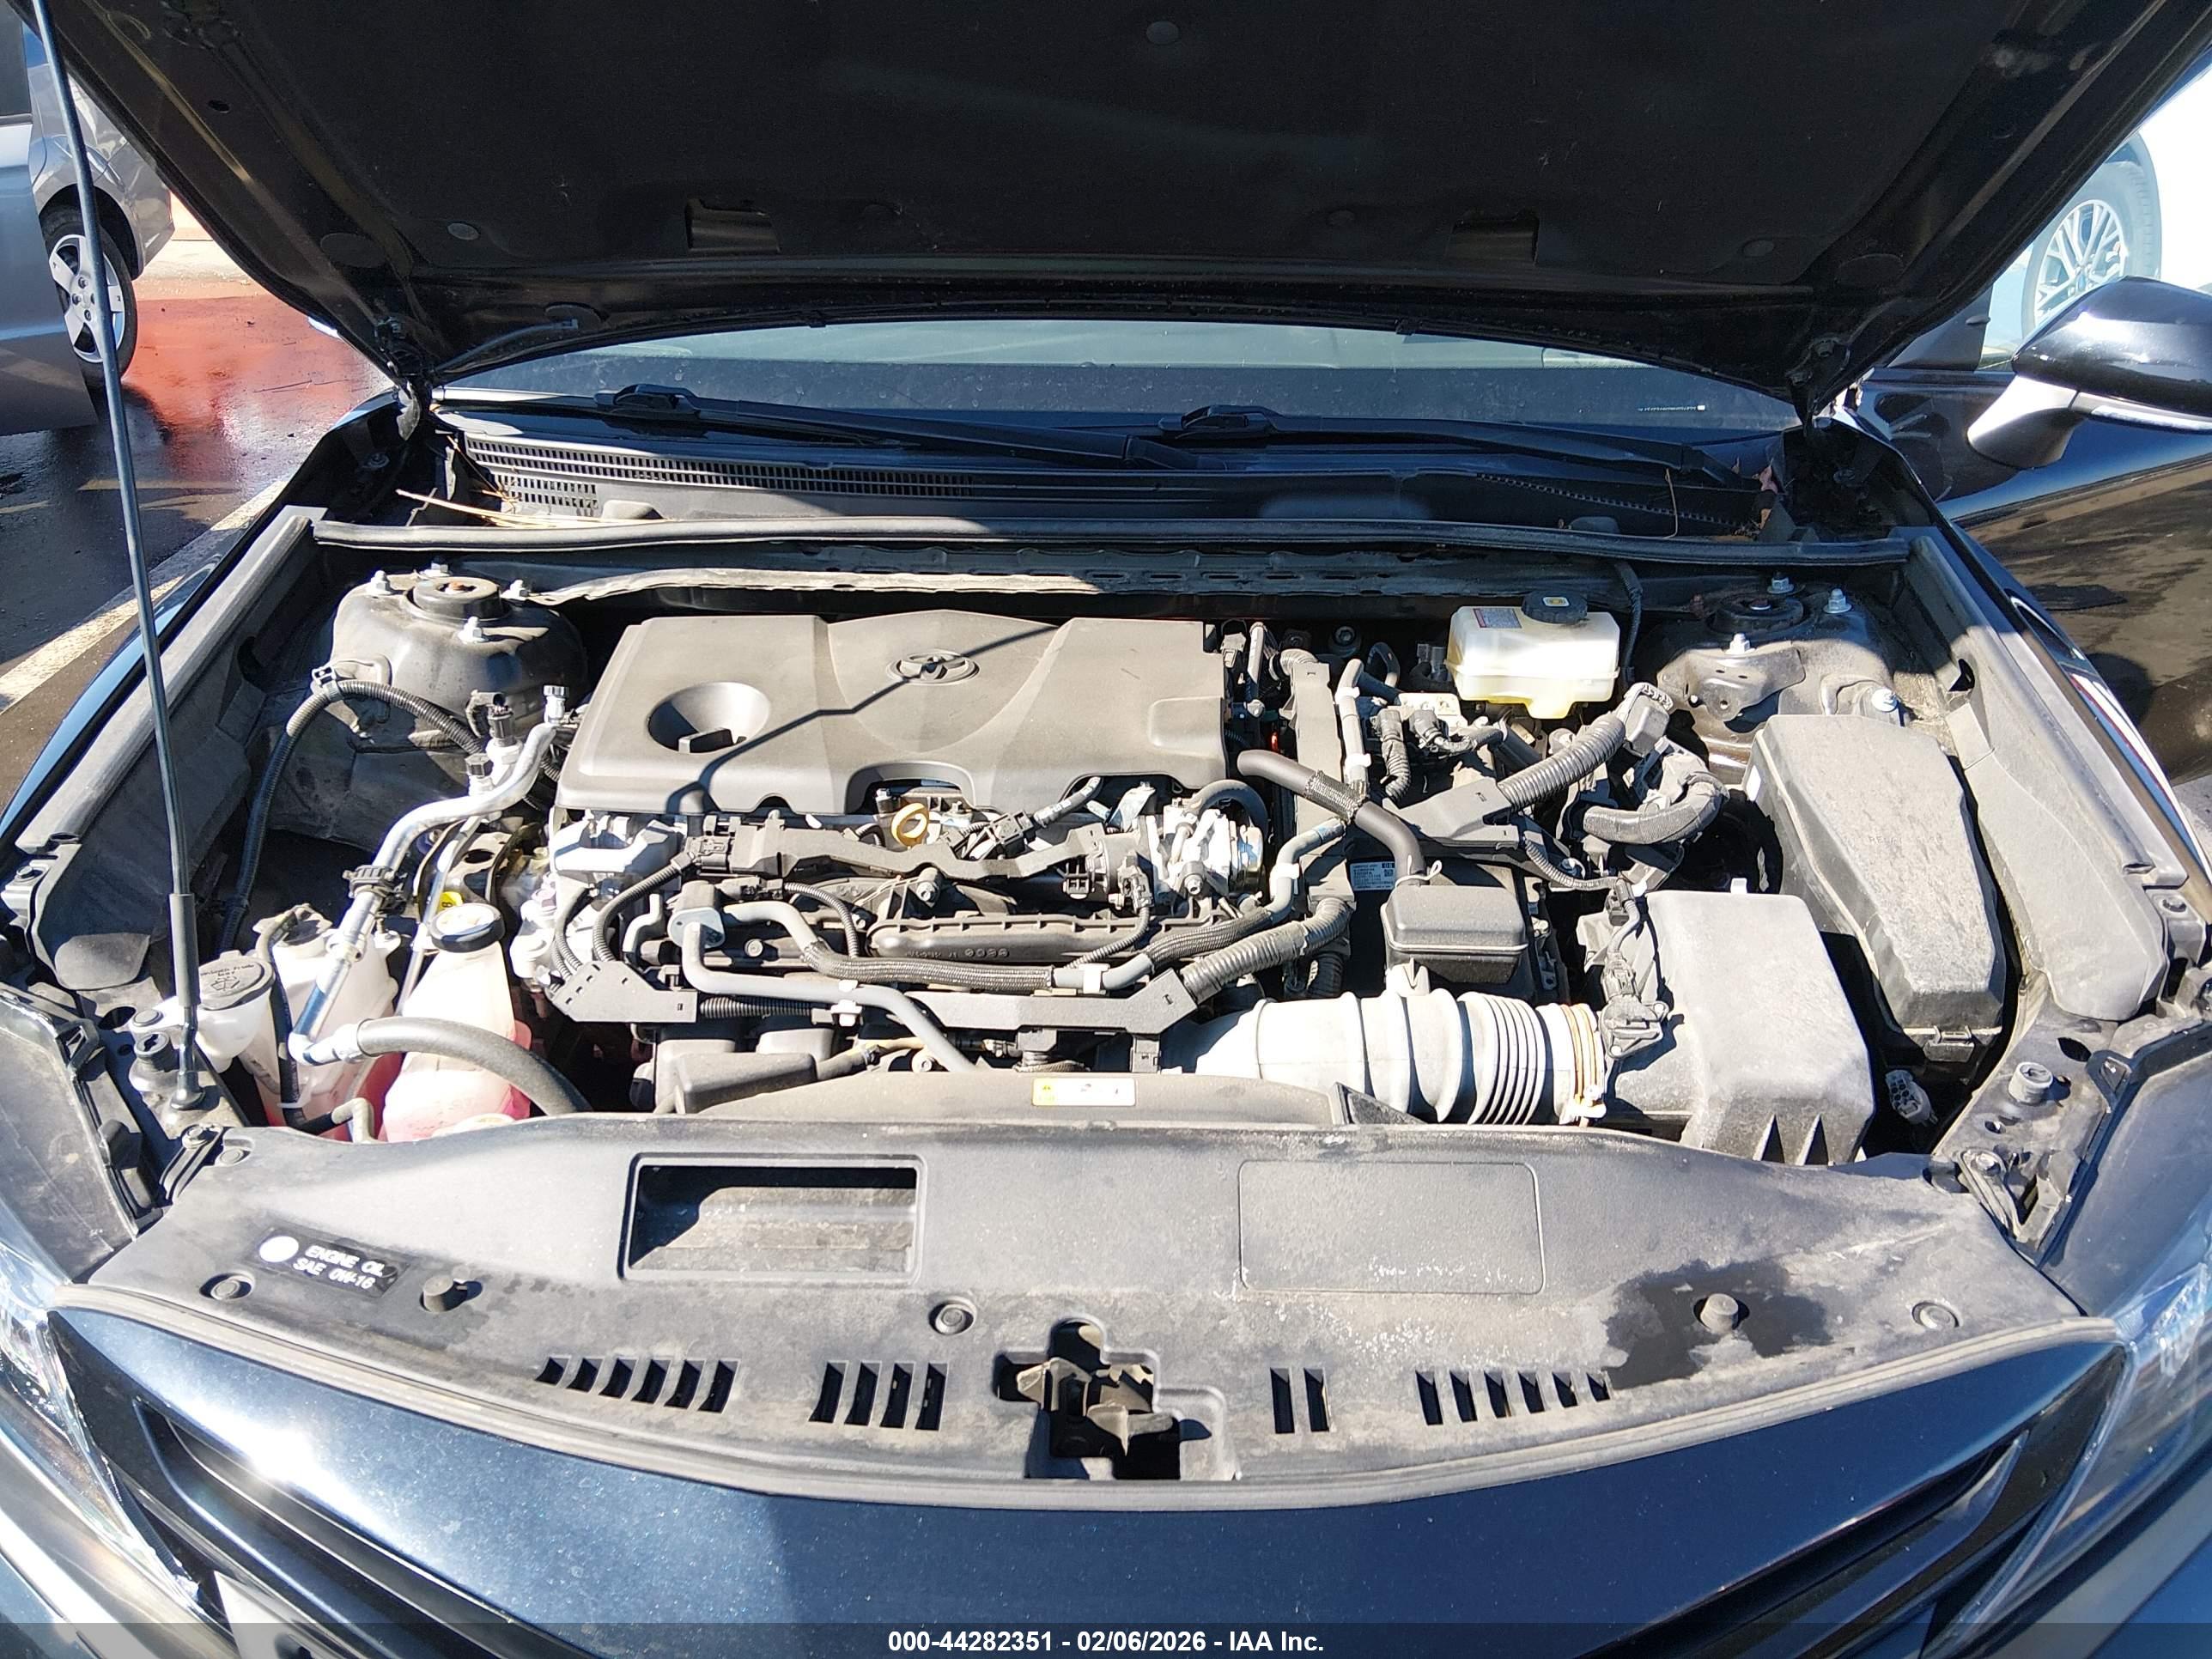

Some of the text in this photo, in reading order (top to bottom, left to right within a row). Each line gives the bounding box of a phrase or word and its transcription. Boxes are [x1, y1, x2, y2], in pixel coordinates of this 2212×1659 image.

[293, 1257, 376, 1289] SAE 0W-16
[305, 1245, 385, 1277] ENGINE OIL
